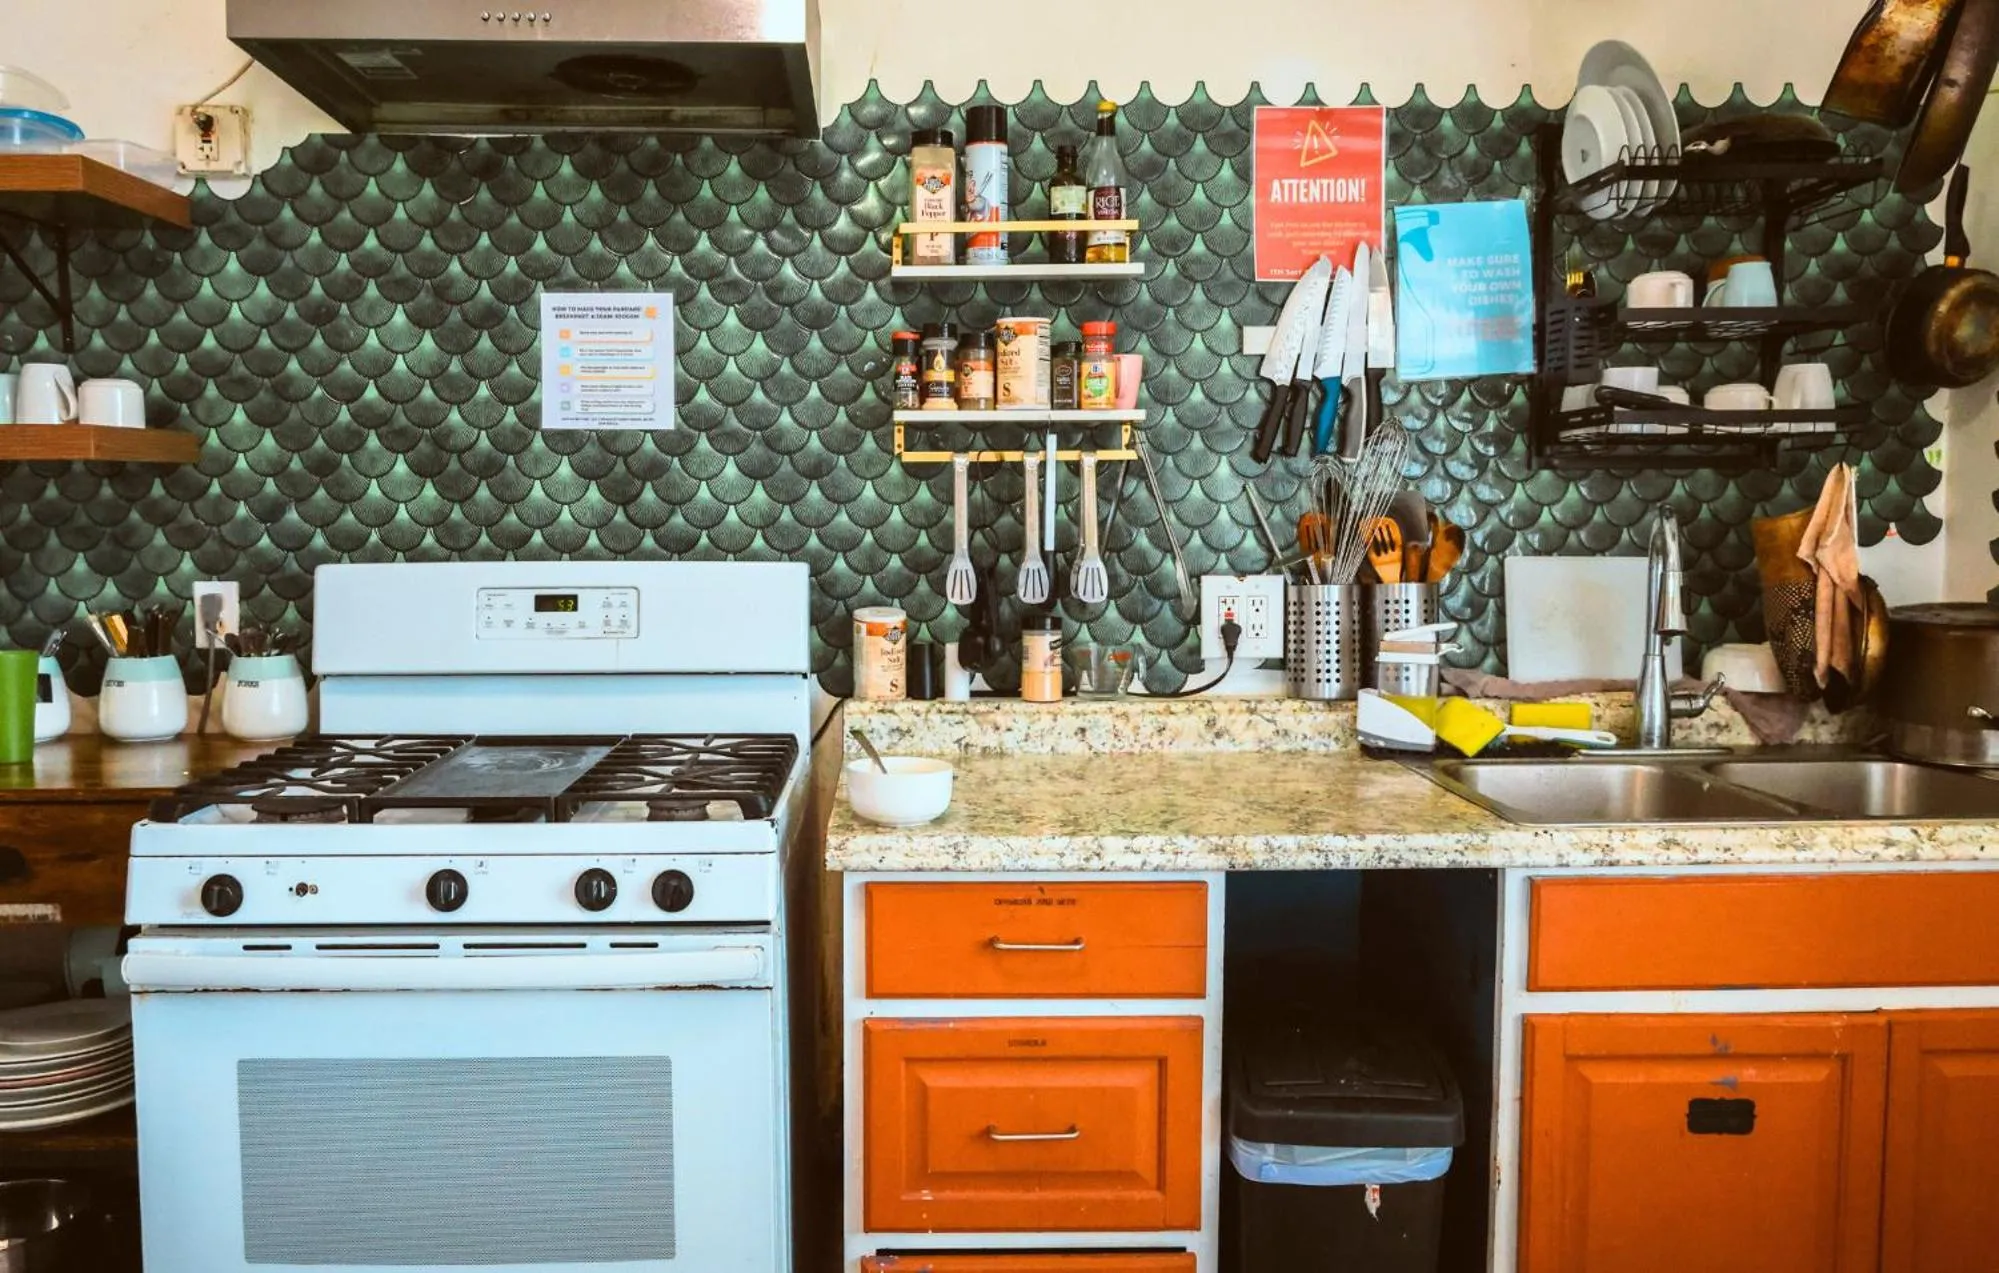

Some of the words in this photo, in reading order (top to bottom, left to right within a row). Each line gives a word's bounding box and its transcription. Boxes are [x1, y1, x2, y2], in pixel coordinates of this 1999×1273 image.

[1270, 178, 1366, 203] ATTENTION!
[1095, 196, 1120, 209] RICE
[1448, 255, 1484, 267] MAKE
[1487, 253, 1520, 265] SURE
[1461, 269, 1480, 279] TO
[1483, 267, 1521, 279] WASH
[1452, 282, 1487, 293] YOUR
[1489, 280, 1522, 291] OWN
[1002, 382, 1011, 397] S
[889, 678, 899, 693] S
